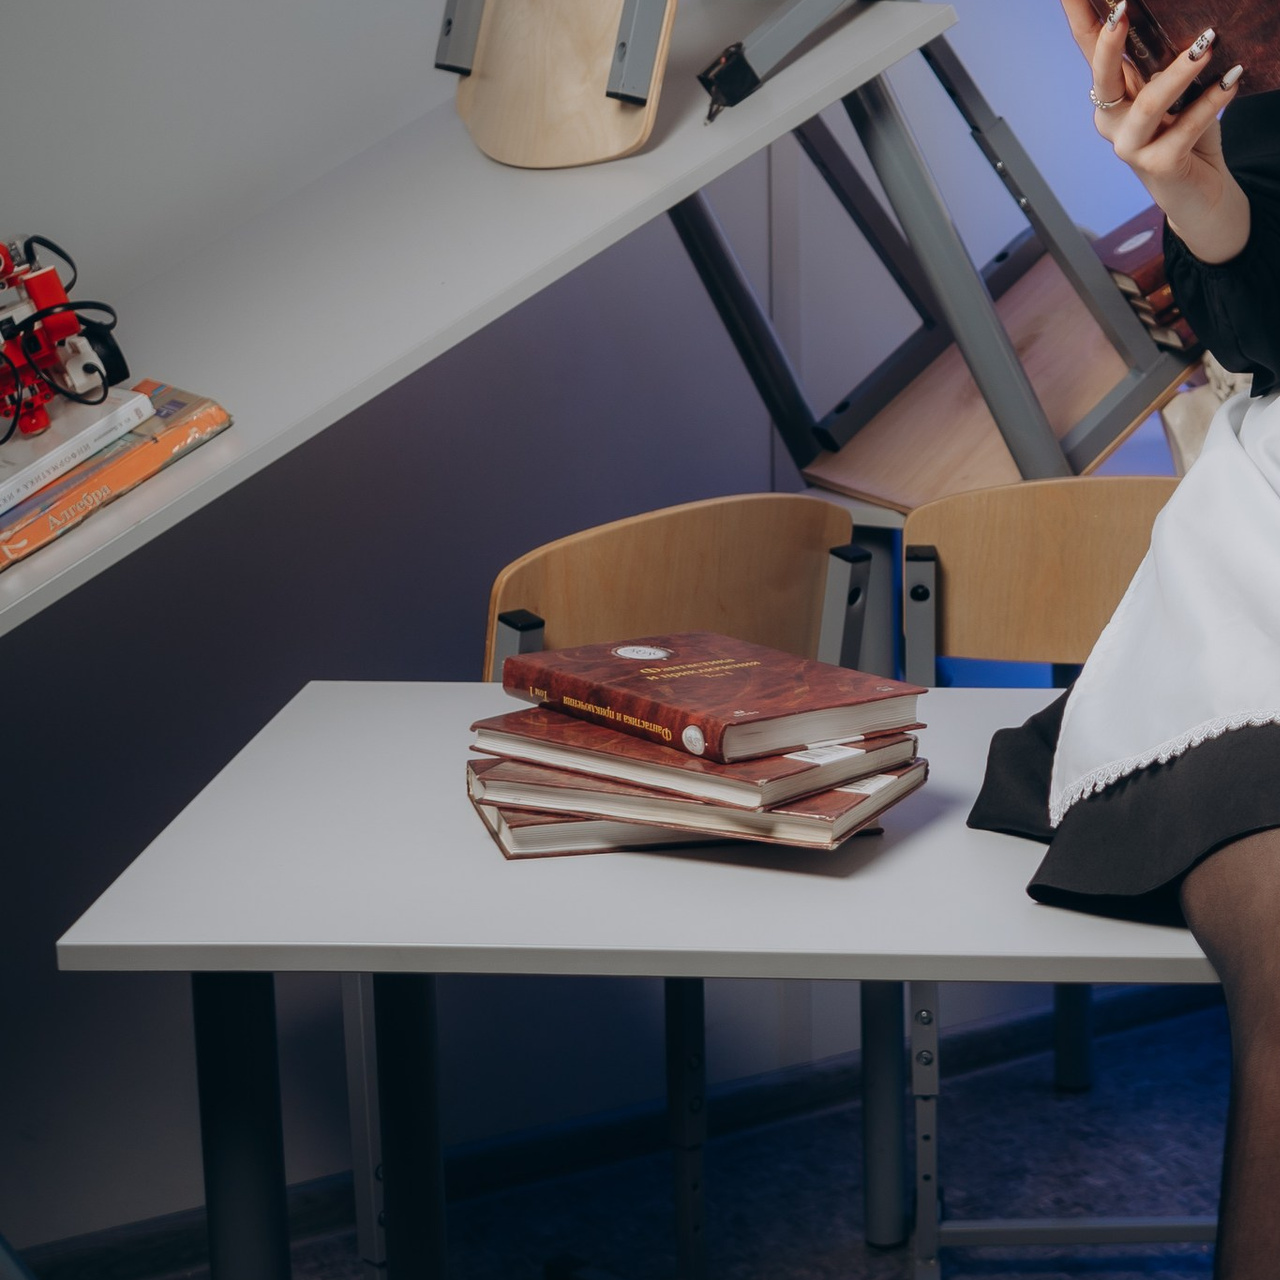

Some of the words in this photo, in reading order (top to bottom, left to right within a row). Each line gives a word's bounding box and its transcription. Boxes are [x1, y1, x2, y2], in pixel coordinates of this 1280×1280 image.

[48, 484, 112, 531] Алгебра
[535, 688, 549, 702] Том
[562, 696, 615, 719] приключения
[616, 712, 622, 722] и
[623, 715, 672, 742] Фантастика
